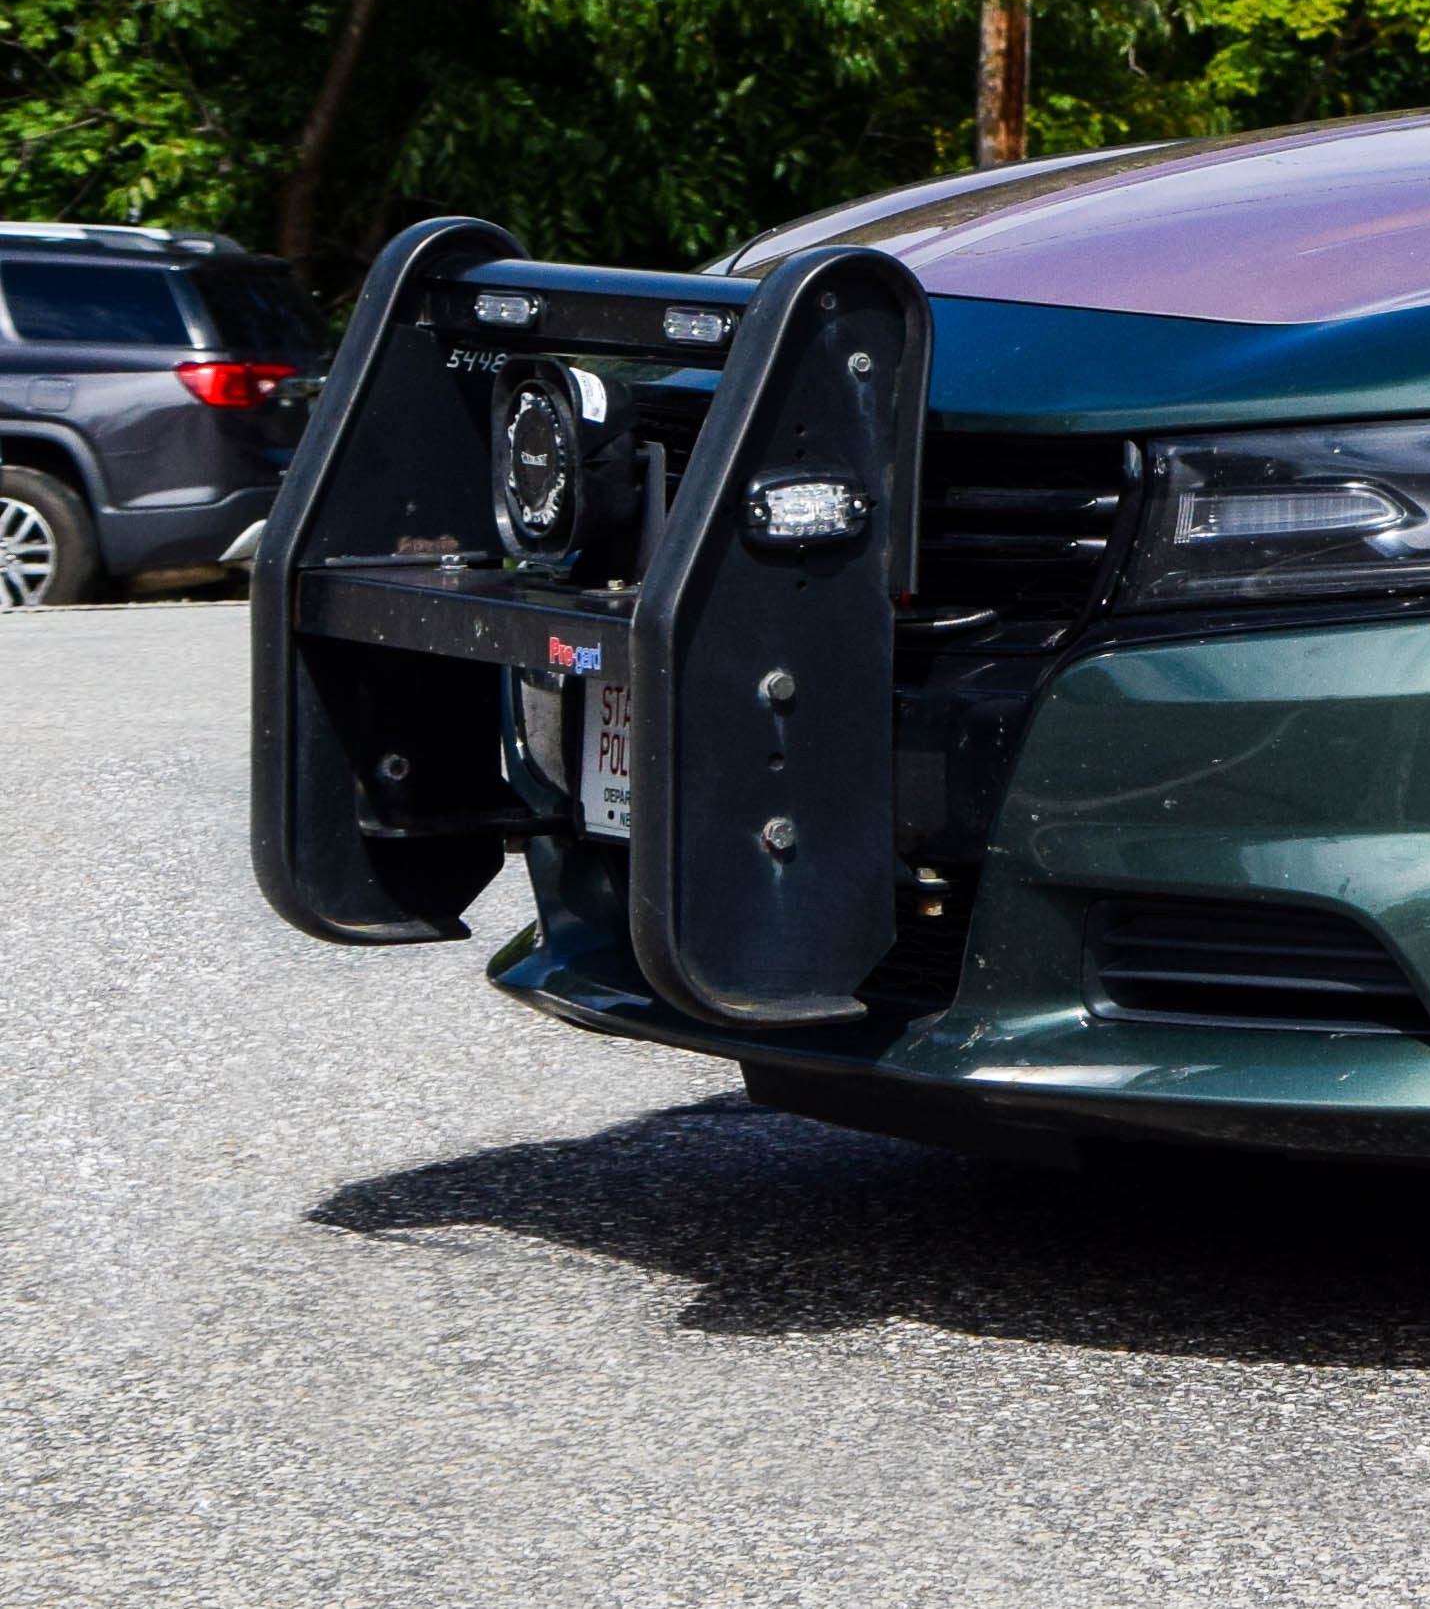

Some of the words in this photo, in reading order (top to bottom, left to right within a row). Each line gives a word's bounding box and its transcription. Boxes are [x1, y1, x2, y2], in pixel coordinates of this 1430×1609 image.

[445, 347, 508, 373] 5448
[601, 685, 631, 727] STA
[598, 731, 631, 778] POL
